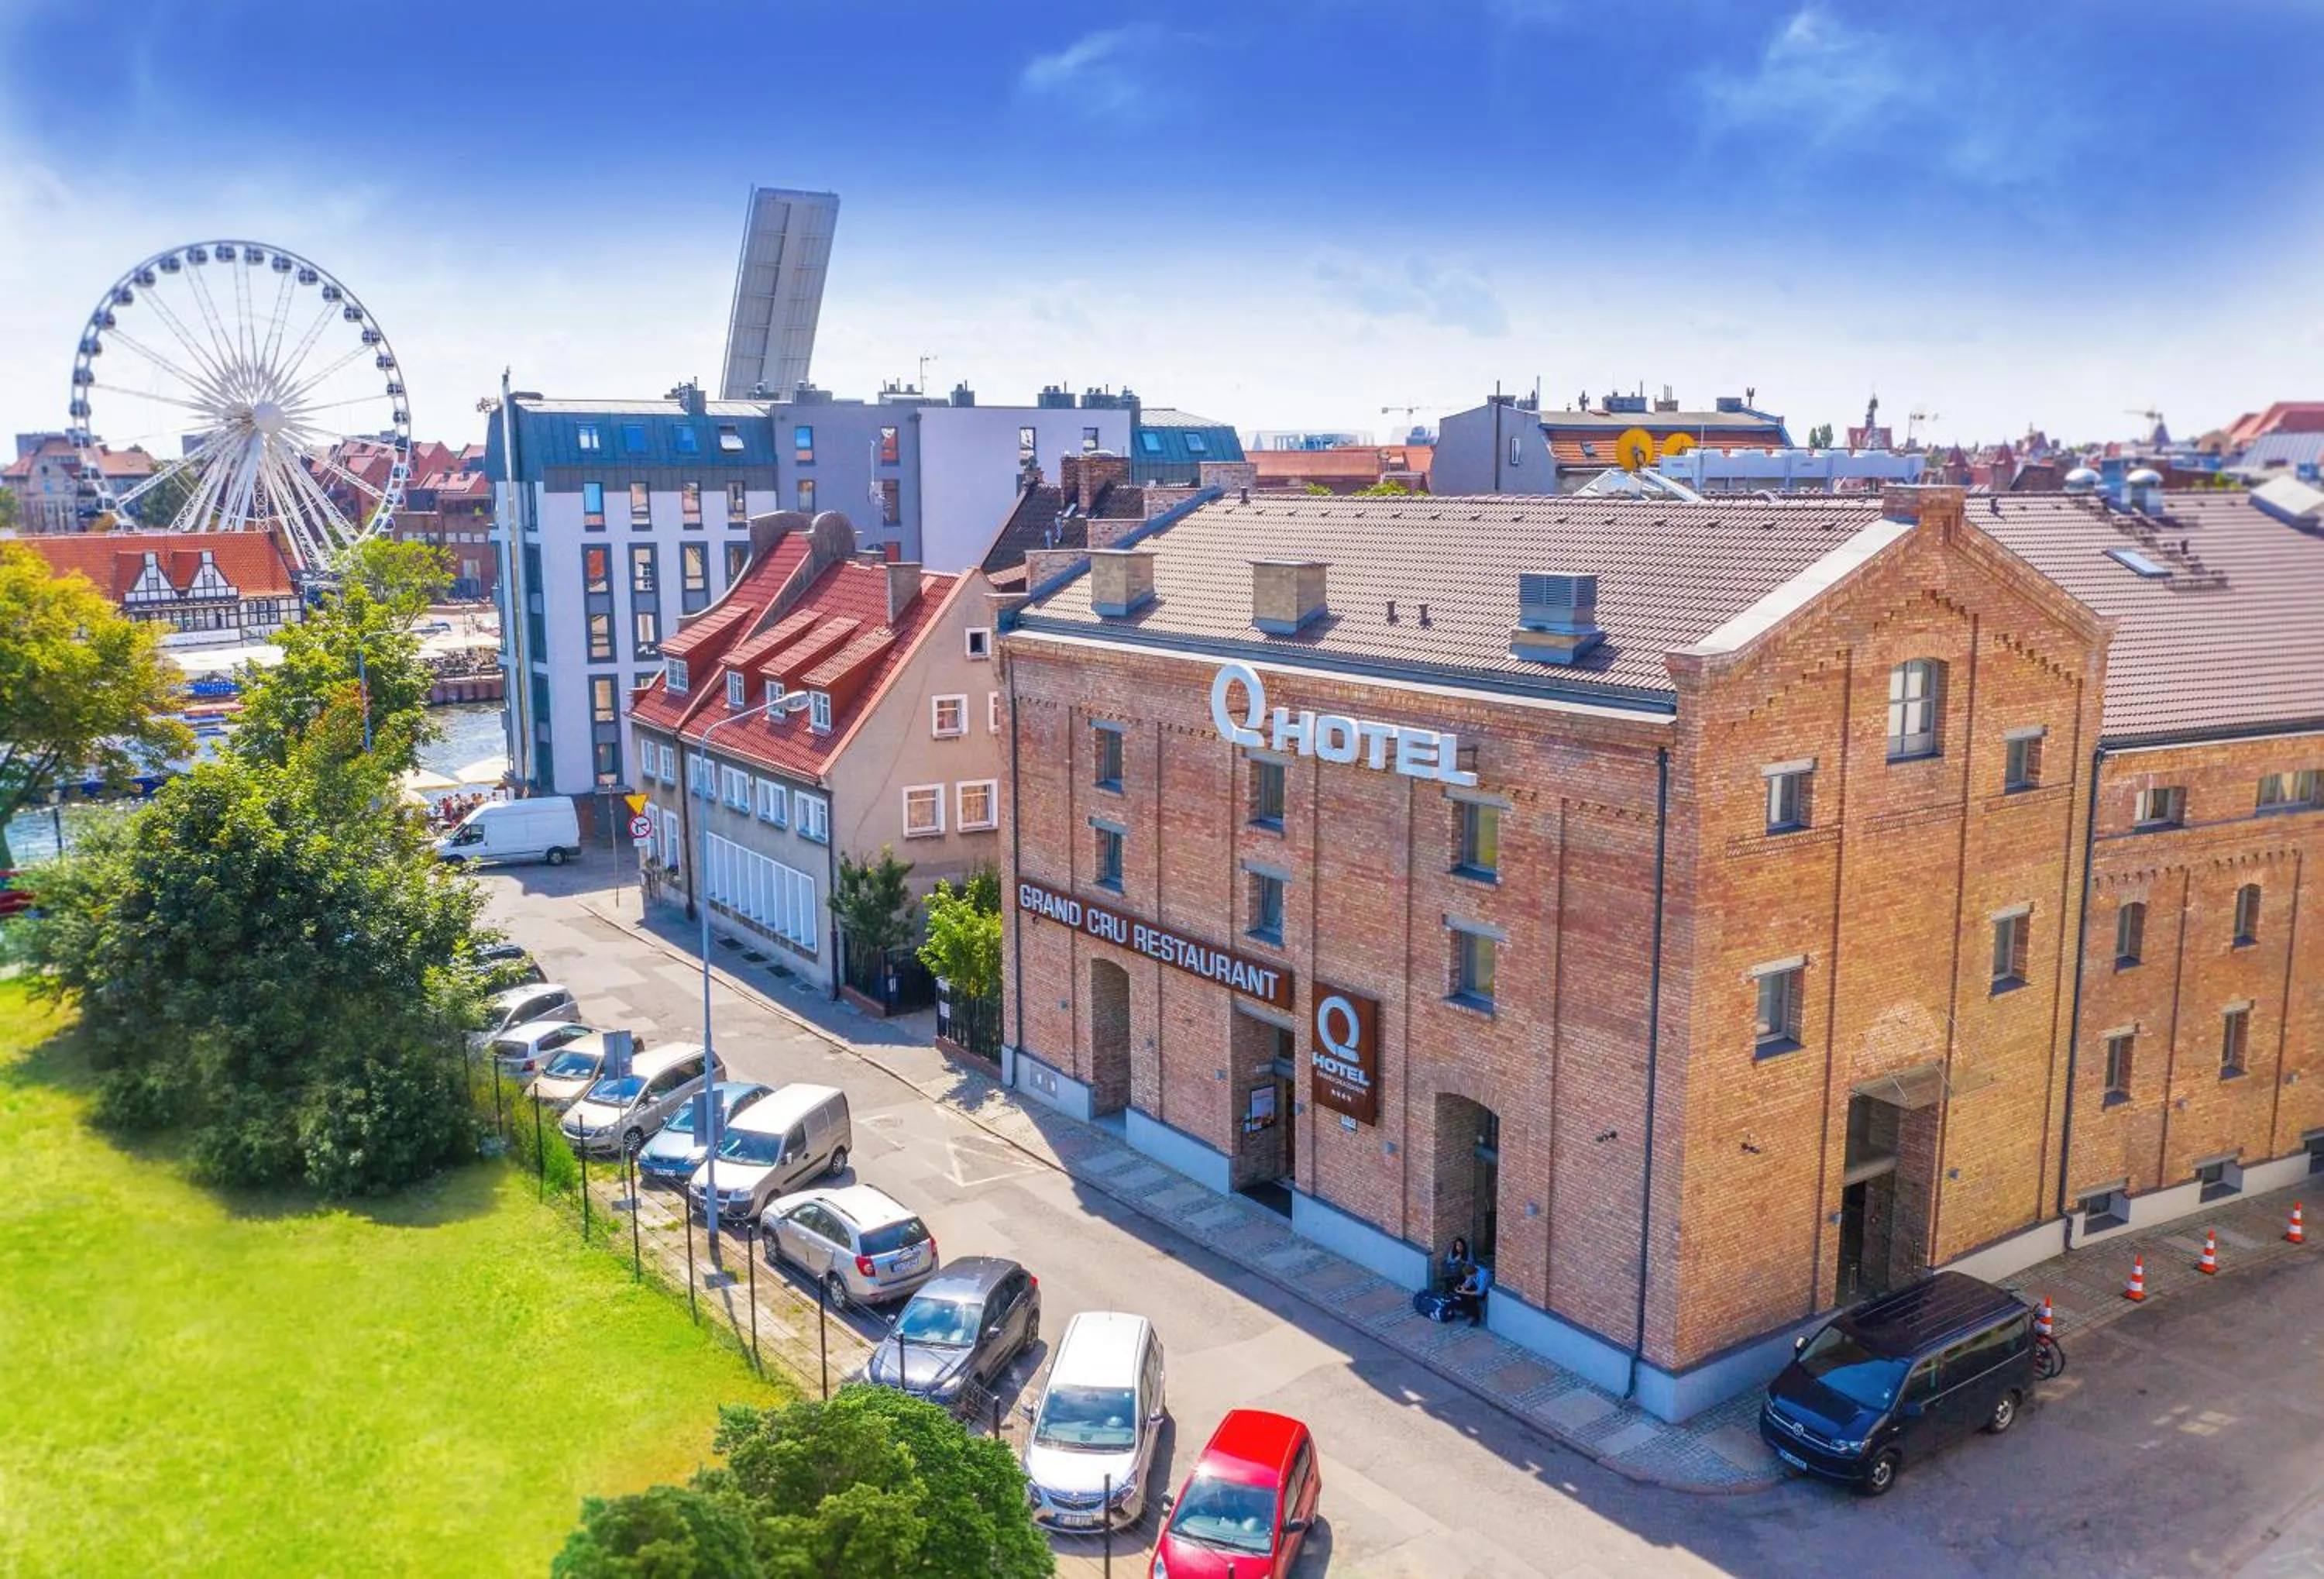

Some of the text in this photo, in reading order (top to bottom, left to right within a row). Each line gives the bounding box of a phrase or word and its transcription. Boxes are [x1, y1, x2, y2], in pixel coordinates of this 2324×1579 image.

[1211, 663, 1477, 786] Q HOTEL
[1019, 884, 1279, 999] GRAND CRU RESTAURANT
[1312, 1052, 1370, 1086] HOTEL
[1318, 996, 1360, 1063] Q
